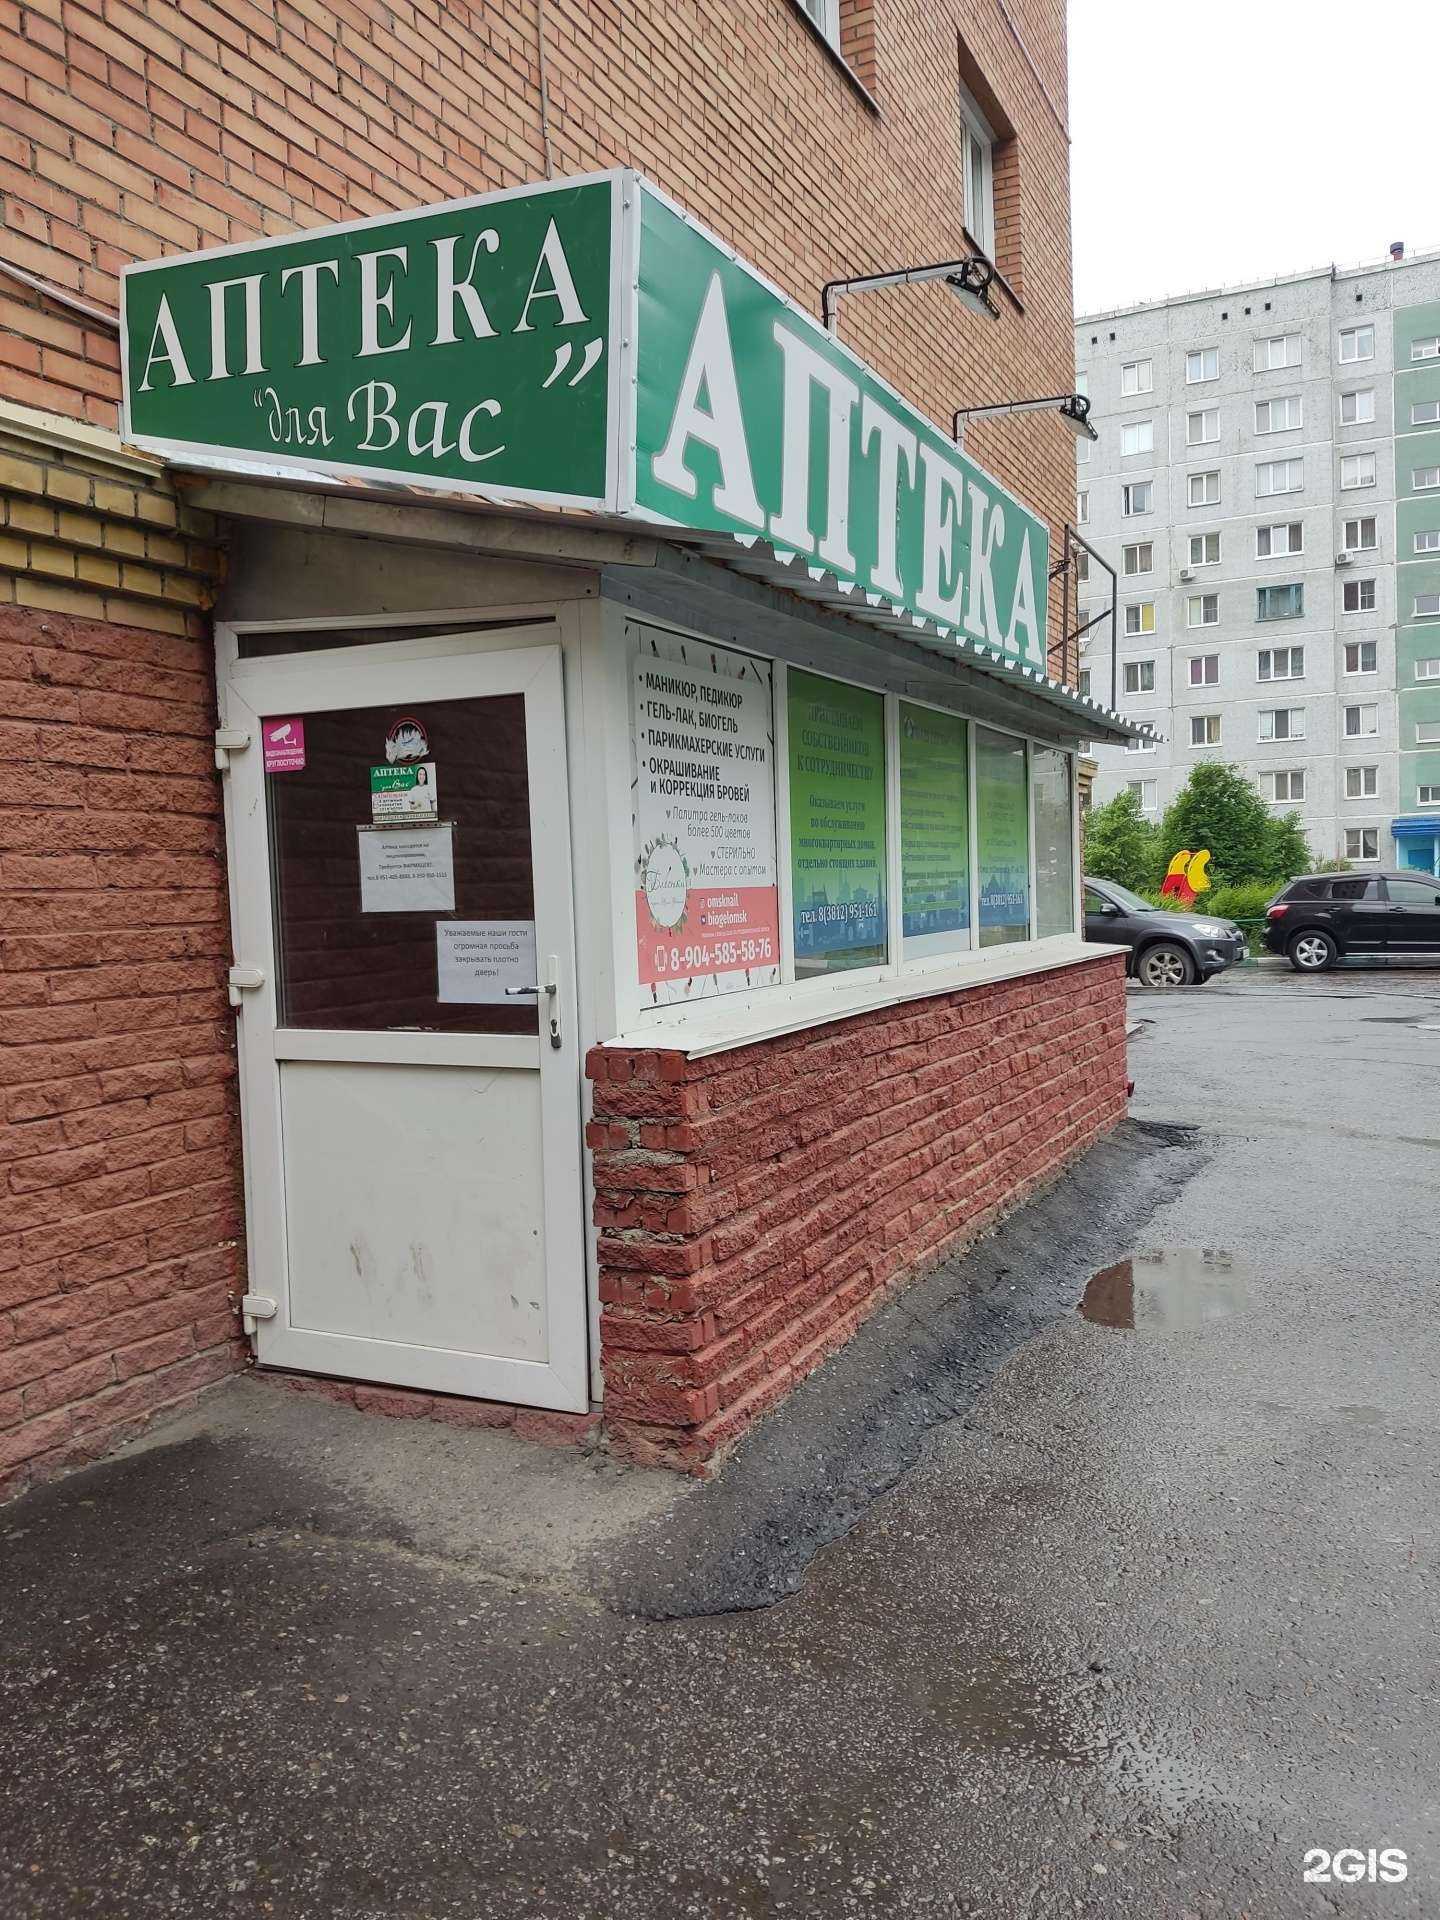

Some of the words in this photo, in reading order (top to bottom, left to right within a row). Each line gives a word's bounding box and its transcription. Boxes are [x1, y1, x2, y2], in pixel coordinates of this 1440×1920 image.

[137, 215, 592, 392] АПТЕКА
[651, 270, 1043, 666] АПТЕКА
[645, 672, 698, 703] МАНИКЮР,
[700, 685, 743, 709] ПЕДИКЮР
[647, 701, 697, 729] ГЕЛЬ-ЛАК,
[699, 711, 738, 733] БИОГЕЛЬ
[648, 728, 732, 758] ПАРИКМАХЕРСКИЕ
[735, 743, 765, 762] УСЛУГИ
[373, 767, 414, 777] АПТЕКА
[649, 757, 720, 781] ОКРАШИВАНИЕ
[650, 781, 657, 794] и
[660, 778, 715, 801] КОРРЕКЦИЯ
[717, 783, 750, 802] БРОВЕЙ
[672, 806, 708, 823] Палитра
[688, 824, 710, 837] более
[711, 825, 724, 837] 500
[725, 828, 750, 839] цветов
[717, 846, 756, 860] СТЕРИЛЬНО
[700, 863, 732, 877] Мастера
[739, 865, 767, 877] опытом
[707, 892, 739, 908] omsknail
[707, 910, 747, 928] biogelomsk
[444, 929, 486, 937] Уважаемые
[453, 943, 488, 951] огромная
[489, 941, 519, 951] просьба
[671, 938, 772, 971] 8-904-585-58-76
[455, 956, 492, 965] закрывать
[493, 956, 519, 964] плотно
